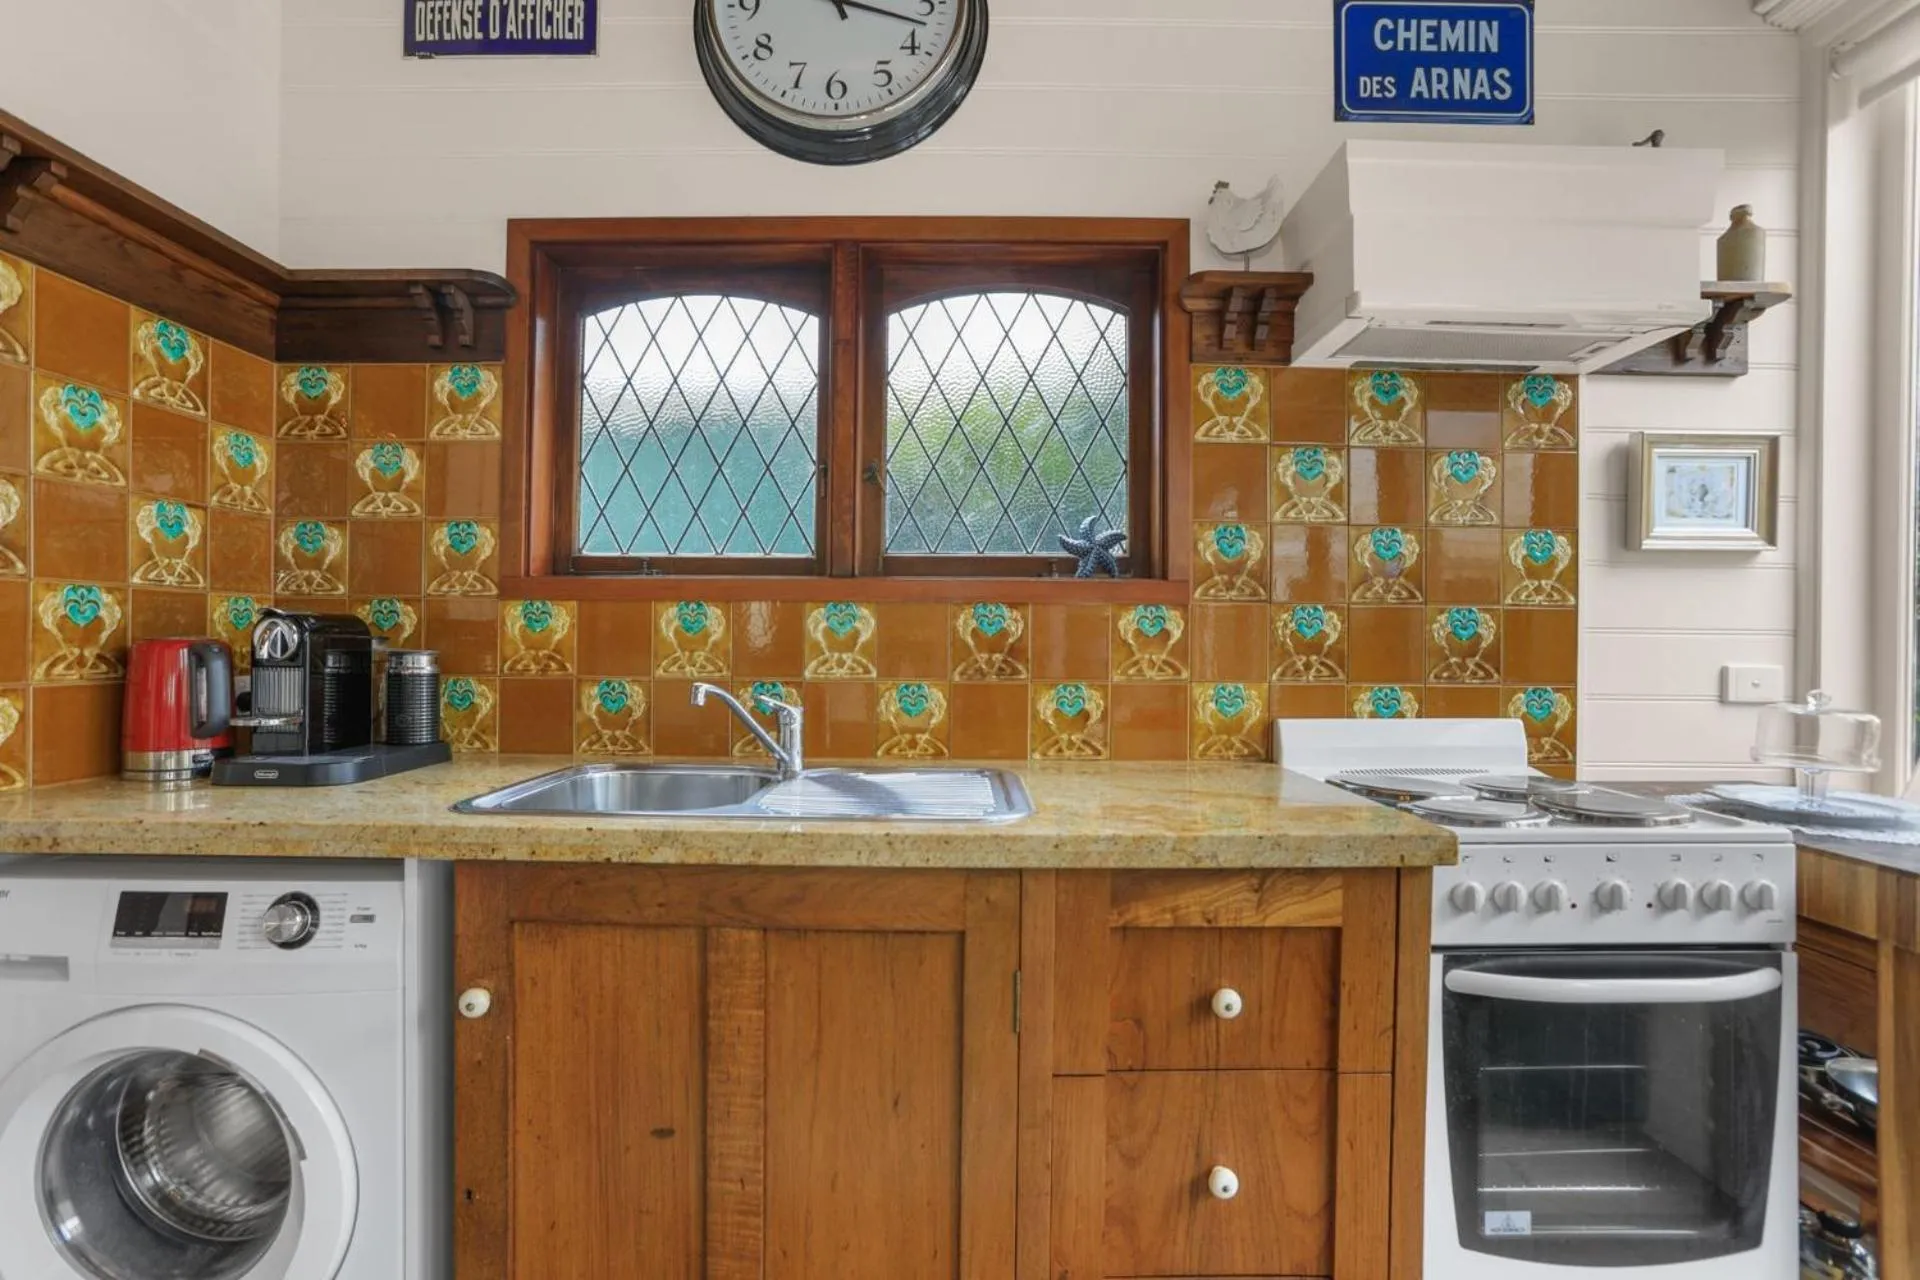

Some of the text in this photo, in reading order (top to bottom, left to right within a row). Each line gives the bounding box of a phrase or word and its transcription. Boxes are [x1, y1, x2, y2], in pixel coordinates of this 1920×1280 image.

[415, 0, 585, 41] DEFENSE D'AFFICHER
[738, 0, 760, 21] 9
[753, 33, 773, 61] 8
[899, 28, 921, 56] 4
[1373, 18, 1500, 53] CHEMIN
[789, 61, 807, 89] 7
[825, 70, 847, 100] 6
[873, 60, 893, 87] 5
[1359, 67, 1513, 101] DES ARNAS
